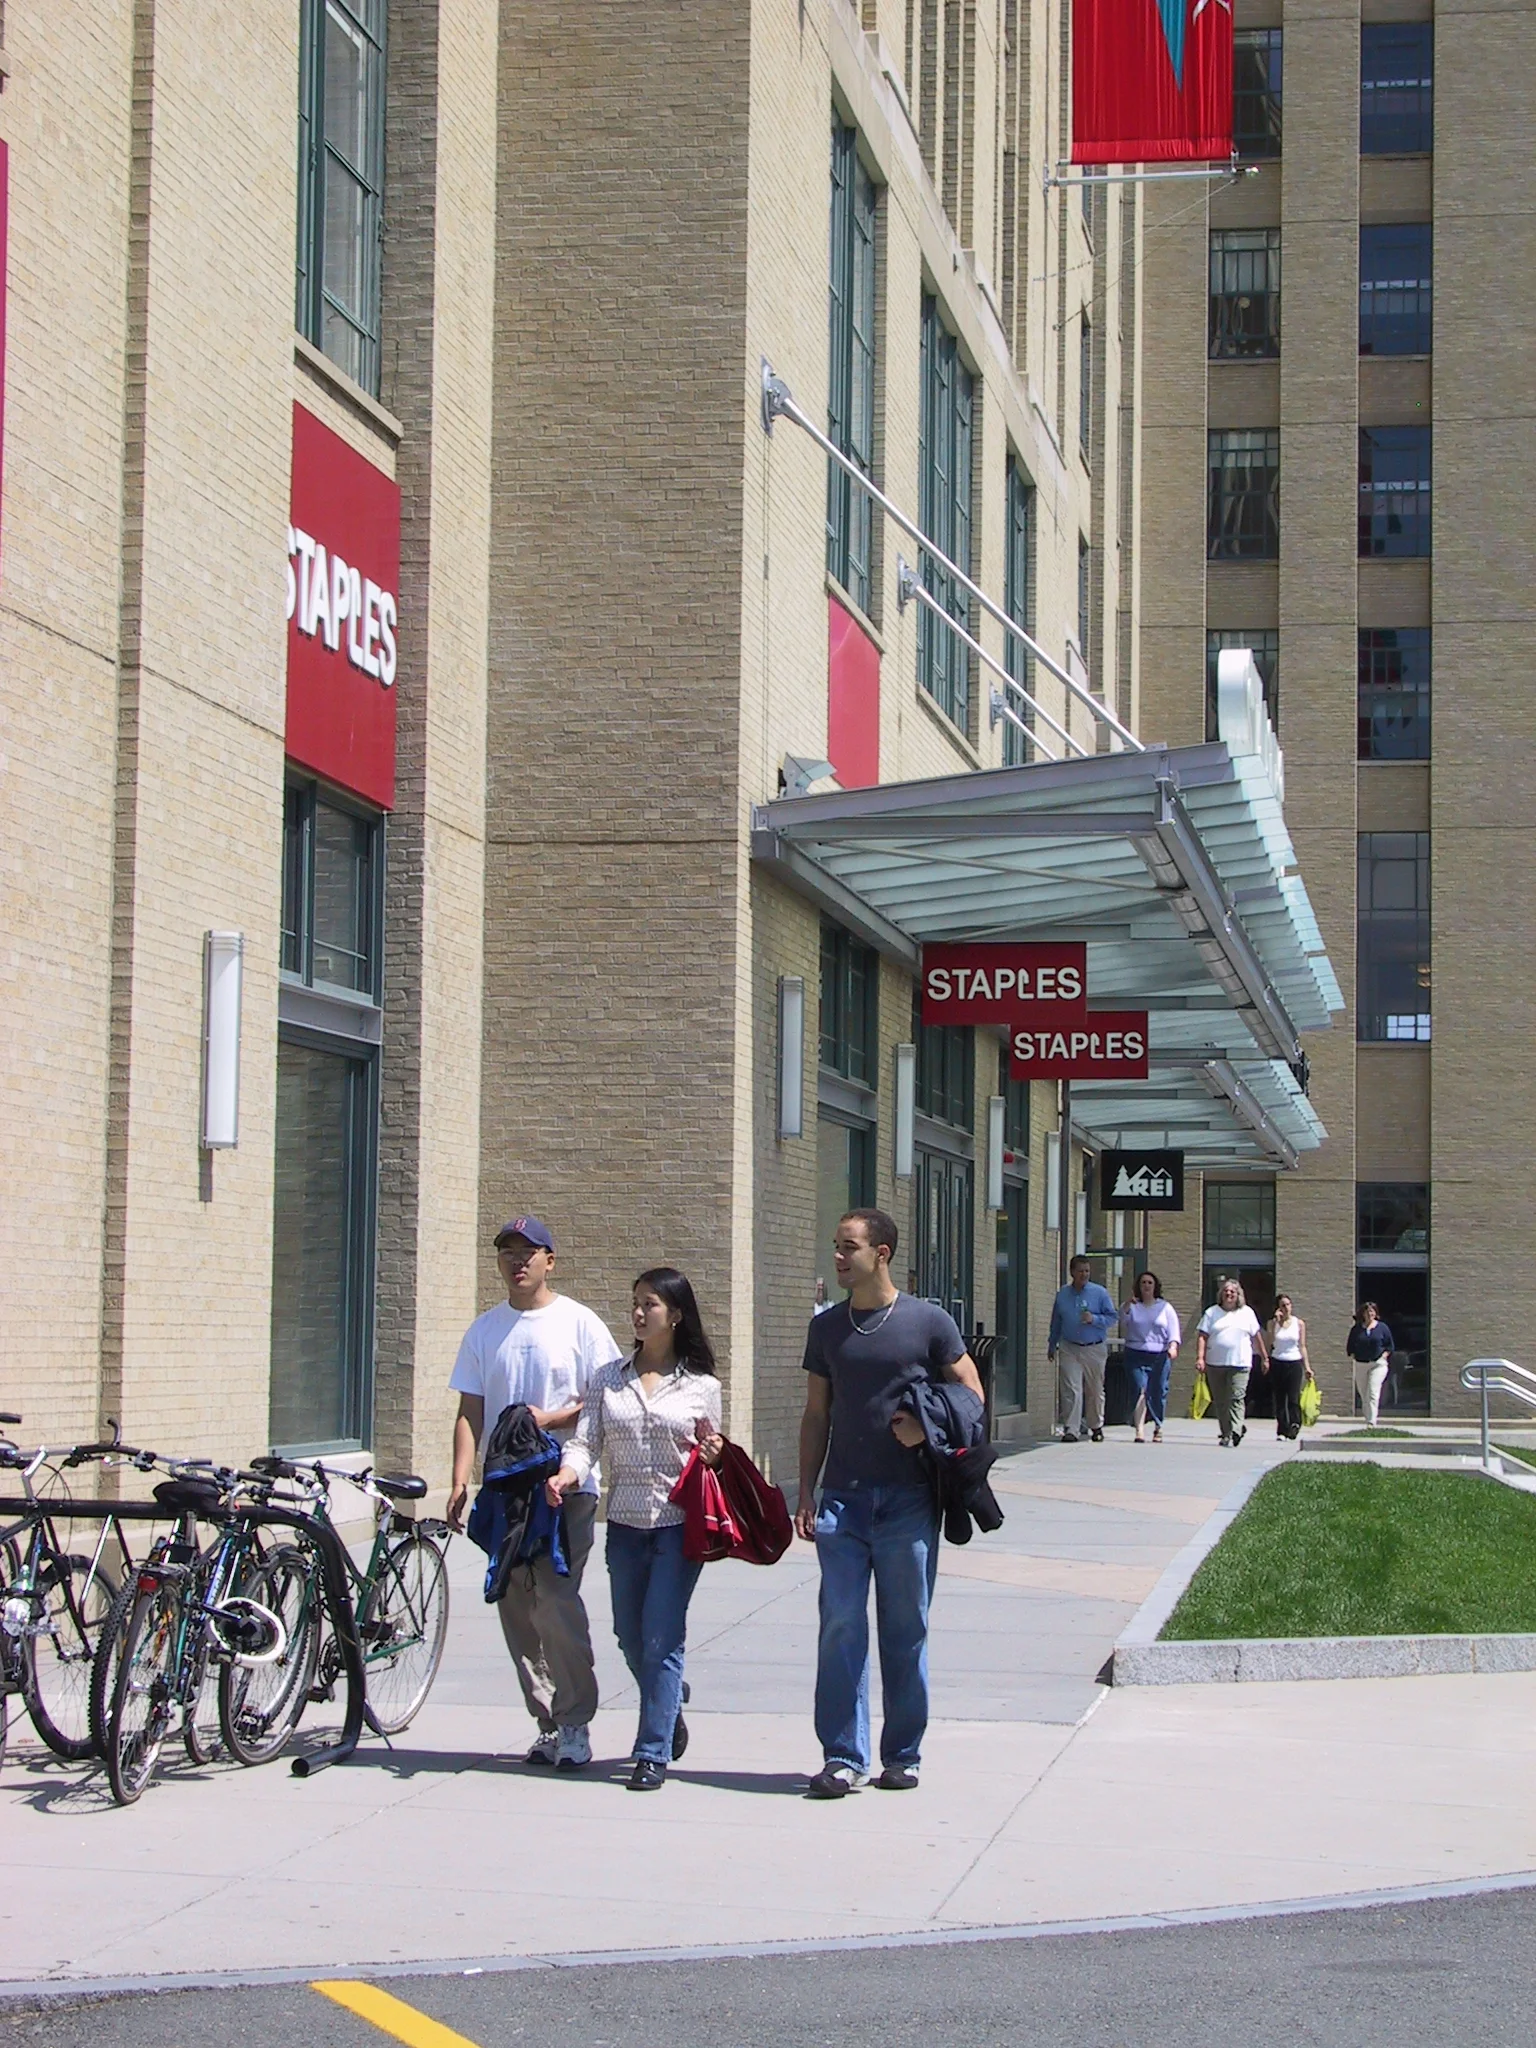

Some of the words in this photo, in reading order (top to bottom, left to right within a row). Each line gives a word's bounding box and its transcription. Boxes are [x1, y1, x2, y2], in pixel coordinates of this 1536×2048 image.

[927, 967, 1082, 1000] STAPLES
[1014, 1032, 1144, 1060] STAPLES
[1131, 1178, 1173, 1197] REI
